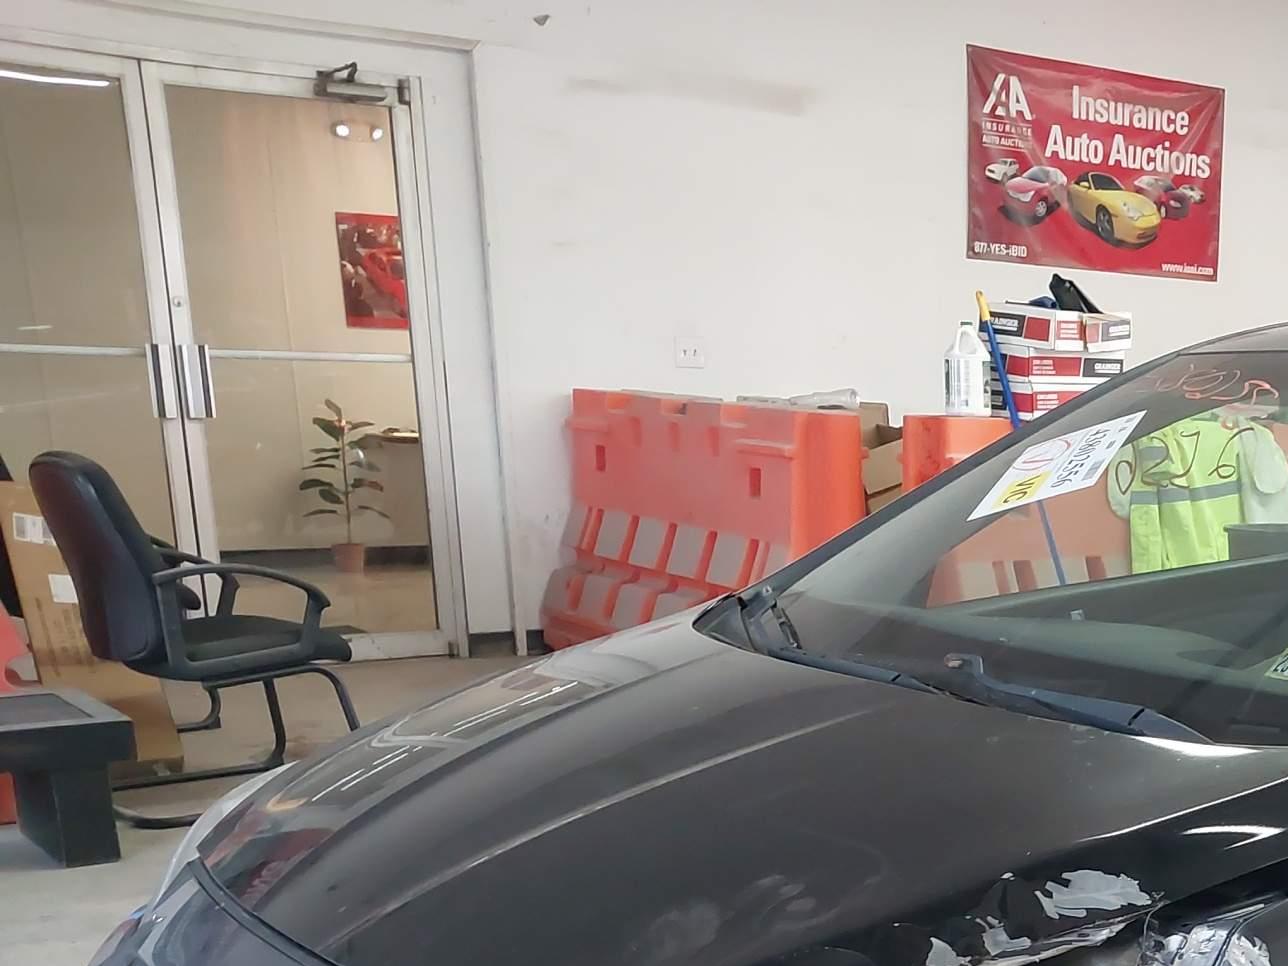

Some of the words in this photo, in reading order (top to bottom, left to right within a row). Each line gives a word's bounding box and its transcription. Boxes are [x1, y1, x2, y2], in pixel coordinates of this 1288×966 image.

[1072, 85, 1190, 136] Insurance
[1045, 125, 1101, 164] Auto
[1108, 134, 1211, 179] Auctions
[1051, 429, 1111, 488] 43802556
[1002, 474, 1042, 504] VIC
